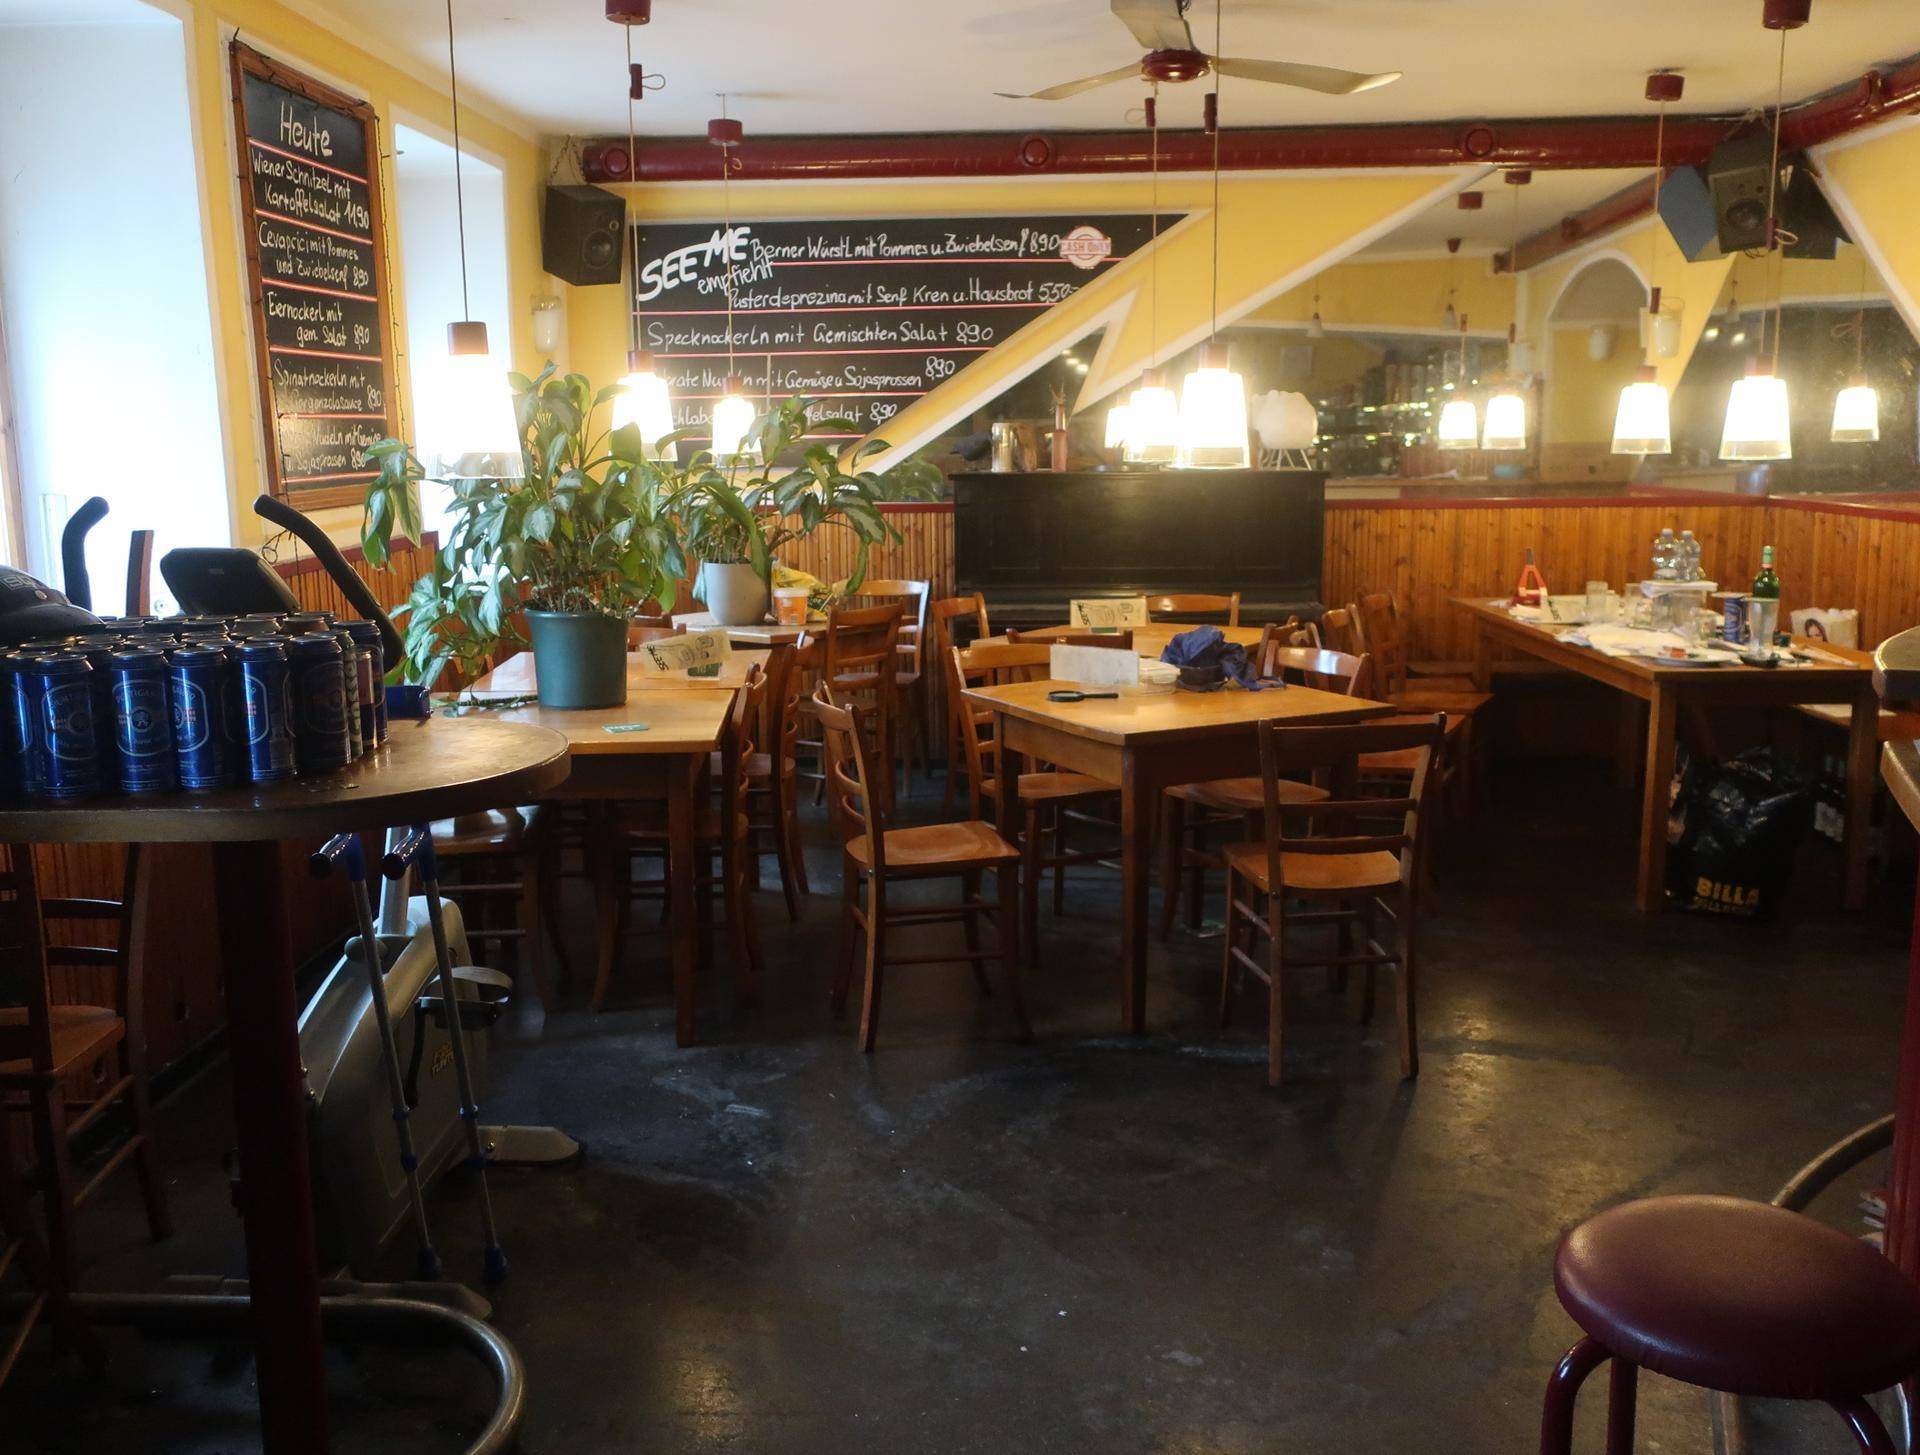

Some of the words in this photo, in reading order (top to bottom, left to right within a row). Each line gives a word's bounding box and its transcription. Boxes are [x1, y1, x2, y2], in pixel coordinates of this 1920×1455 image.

[280, 100, 334, 157] Heute
[252, 149, 285, 177] Wiener
[286, 160, 332, 194] Schnitzel
[334, 179, 350, 200] mit
[265, 181, 342, 226] Kartoffelsalat
[310, 236, 326, 254] mit
[327, 236, 359, 261] Pommes
[703, 226, 751, 267] ME
[751, 238, 803, 262] Berner
[854, 235, 876, 257] mit
[877, 233, 928, 256] Pommes
[276, 254, 293, 274] und
[296, 257, 349, 290] Zwiebelsenf
[847, 283, 872, 304] mit
[876, 285, 908, 307] Senf
[913, 285, 949, 304] Kren
[969, 277, 1034, 302] Hausbrot
[326, 302, 342, 322] mit
[322, 325, 347, 347] Salat
[647, 321, 769, 352] Specknockerln
[775, 323, 805, 344] mit
[813, 322, 897, 344] Gemischten
[899, 321, 949, 342] Salat
[349, 365, 365, 389] mit
[844, 366, 922, 391] Sojasprossen
[1696, 875, 1761, 907] BILLA
